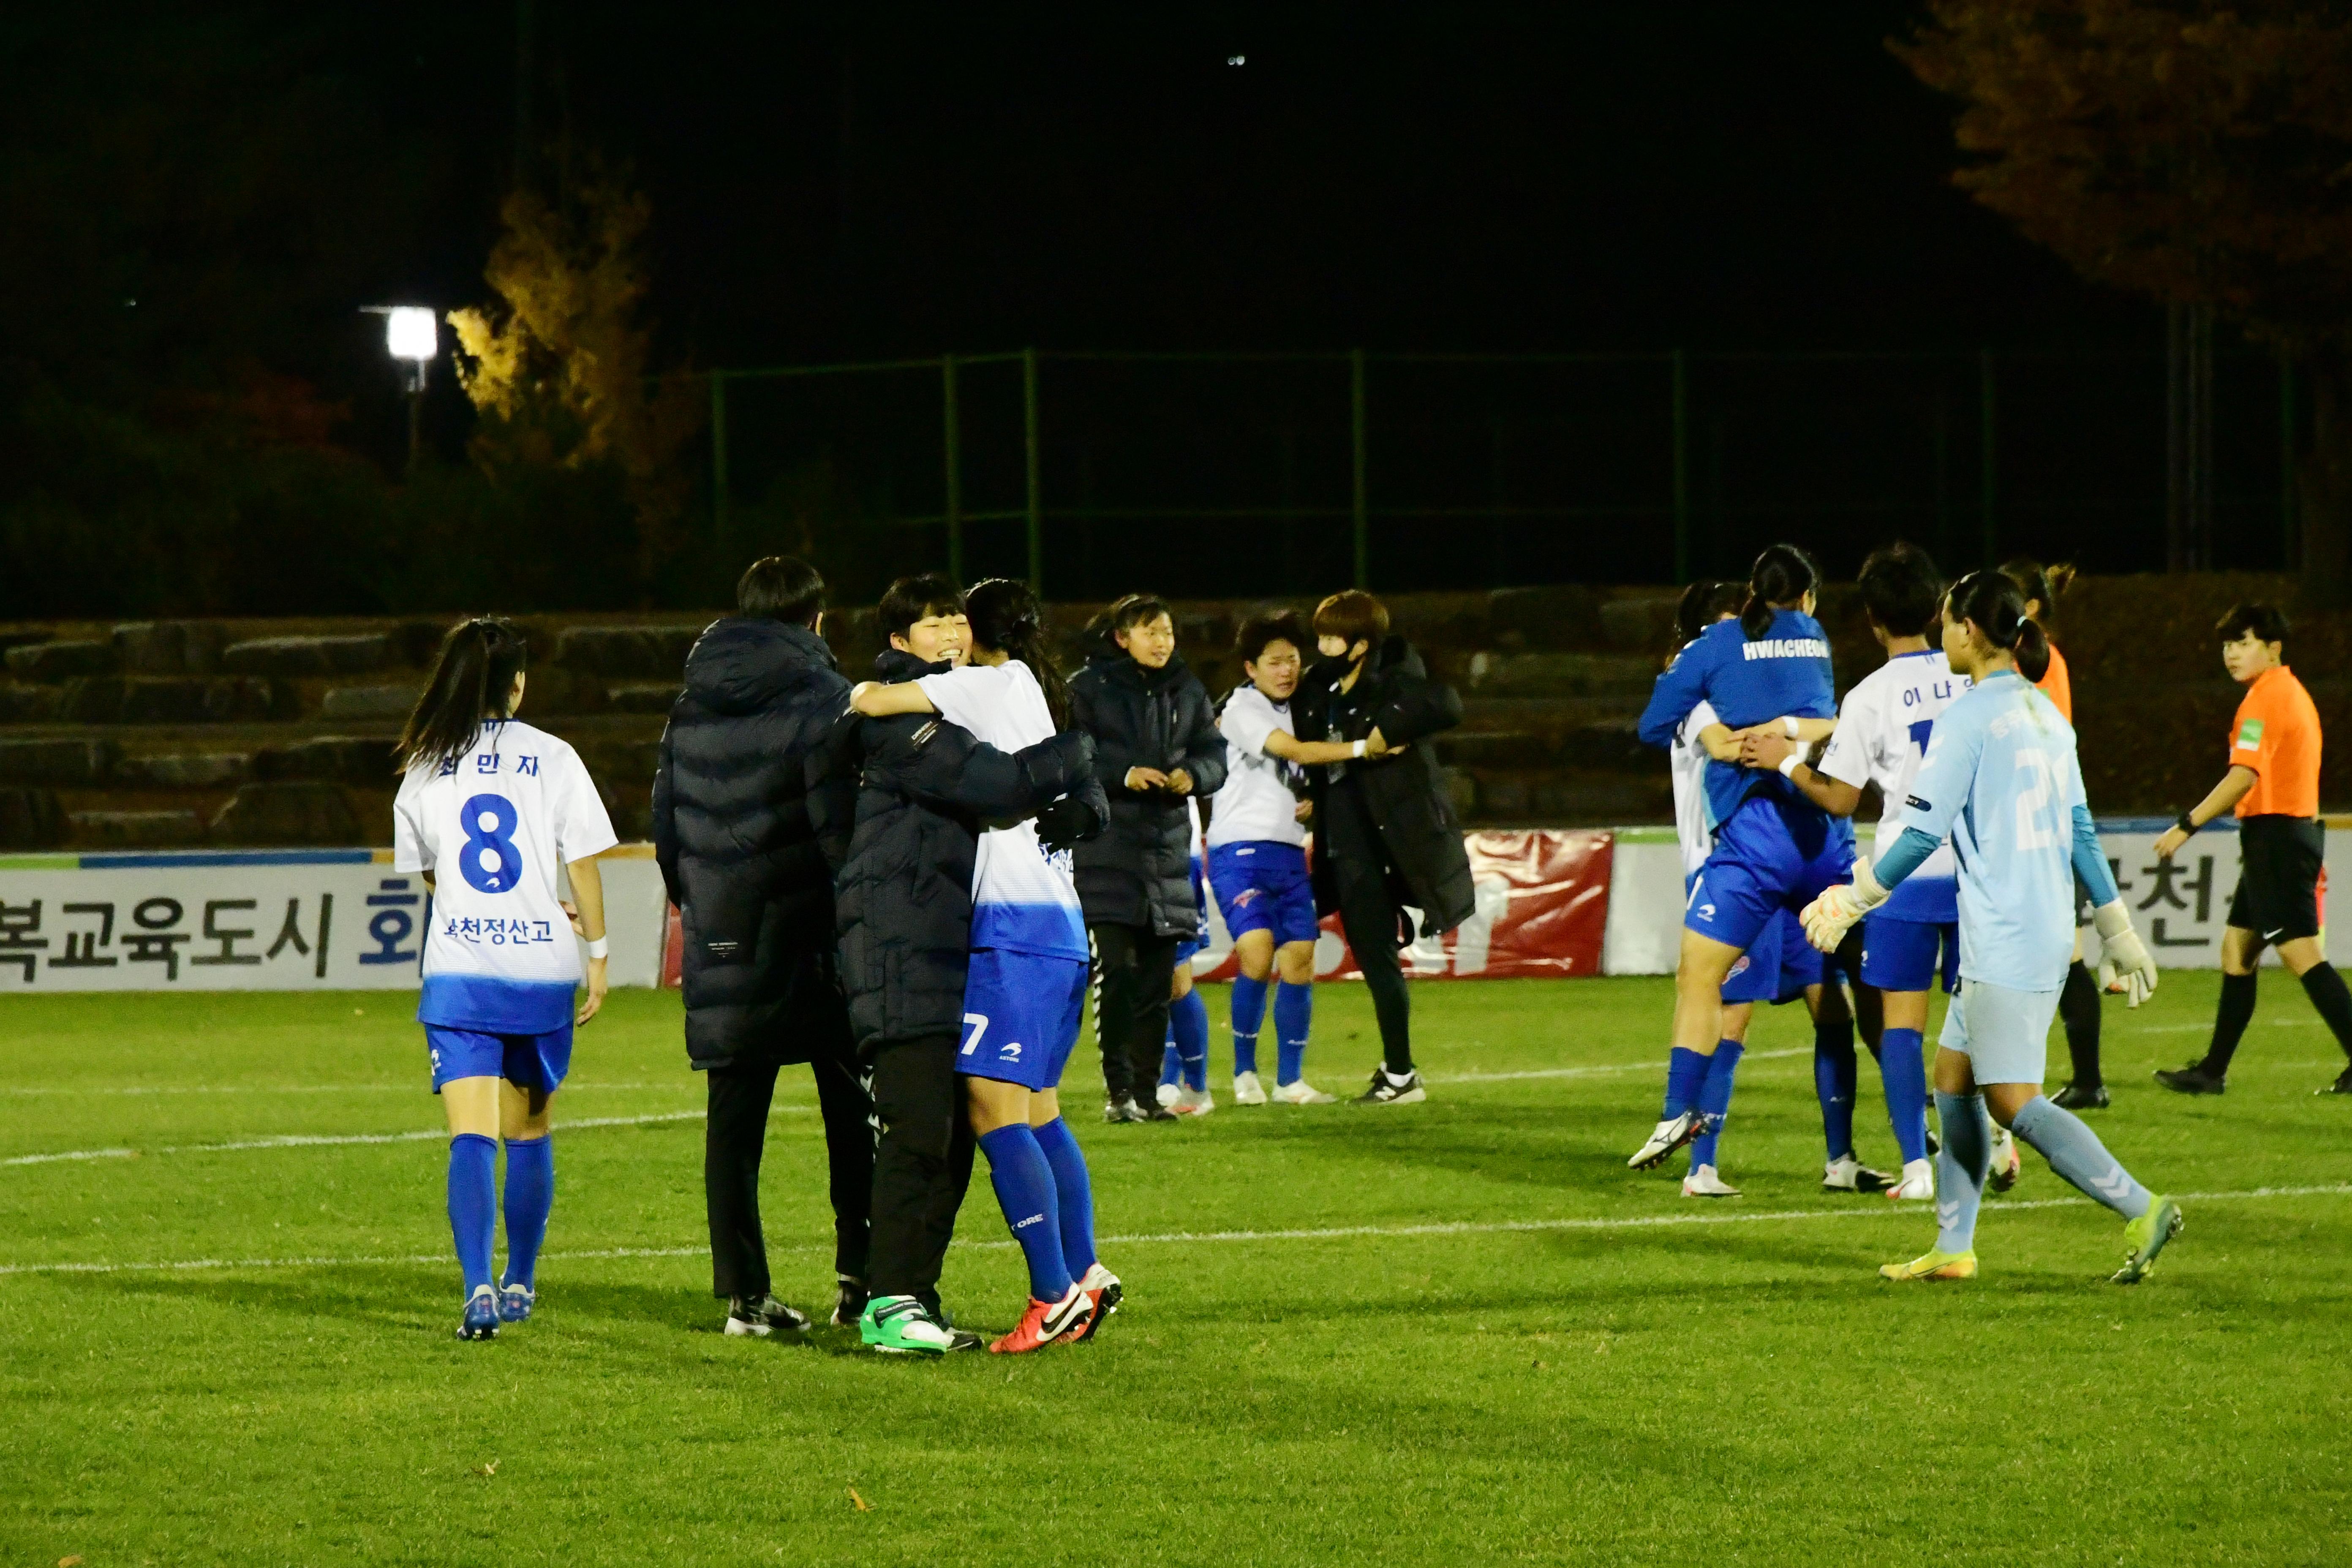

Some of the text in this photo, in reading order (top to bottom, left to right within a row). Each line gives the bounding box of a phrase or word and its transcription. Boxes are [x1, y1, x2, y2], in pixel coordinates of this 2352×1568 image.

[1742, 638, 1829, 661] HWACHEON
[460, 794, 523, 893] 8
[961, 1013, 989, 1055] 7
